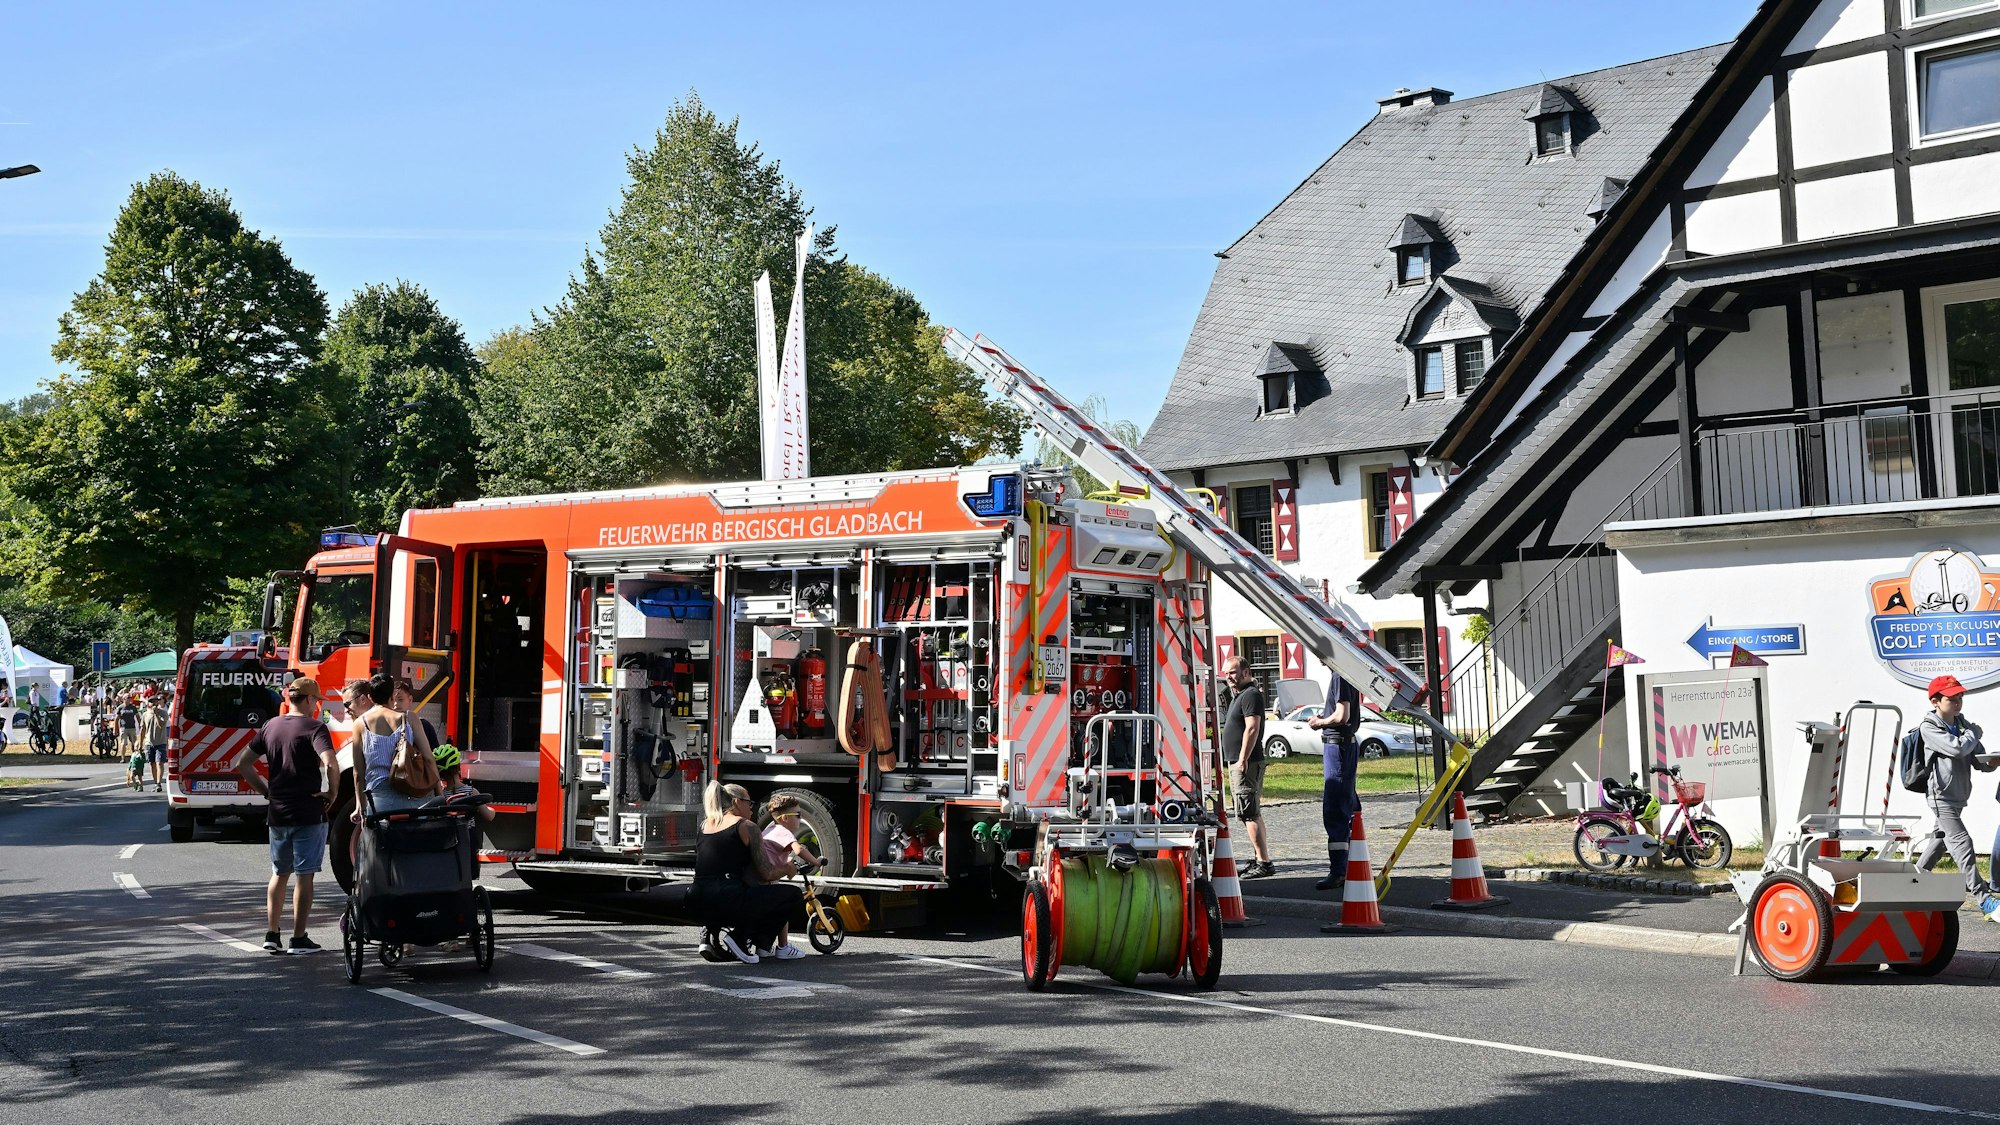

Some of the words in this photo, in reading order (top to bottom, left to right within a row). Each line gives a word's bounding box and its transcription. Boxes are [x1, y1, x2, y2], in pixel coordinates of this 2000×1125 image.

[1106, 504, 1130, 519] Lentner
[599, 522, 707, 546] FEUERWEHR
[711, 516, 805, 541] BERGISCH
[809, 510, 923, 537] GLADBACH
[1890, 622, 1942, 633] FREDDY'S
[1946, 620, 2000, 631] EXCLUSIV
[1708, 636, 1753, 645] EINGANG
[1761, 634, 1794, 643] STORE
[1882, 634, 1927, 649] GOLF
[1045, 648, 1054, 661] GL
[1947, 659, 1994, 667] VERMIETUNG
[202, 672, 286, 686] FEUERWE
[1671, 690, 1736, 702] Herrenstrunden
[1702, 720, 1757, 741] WEMA
[1732, 743, 1758, 755] GmbH
[214, 760, 230, 769] 112
[1707, 757, 1759, 768] www.wemacare.de
